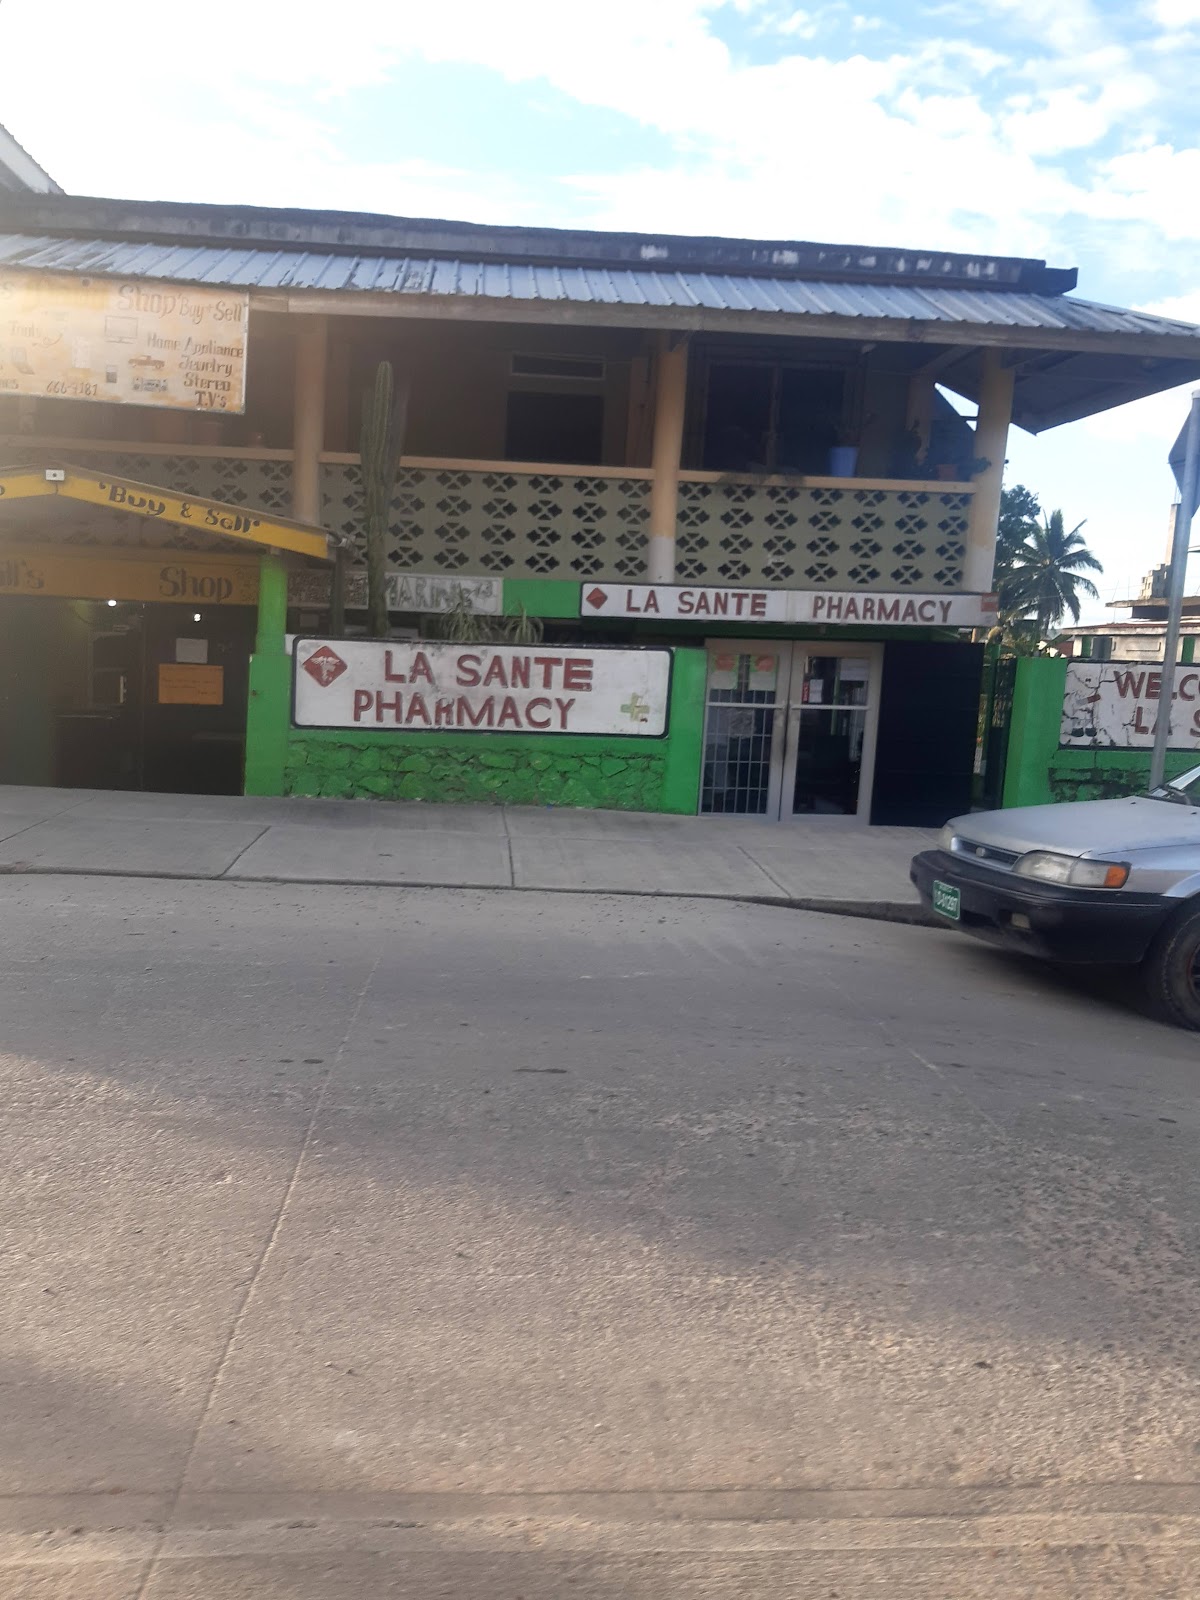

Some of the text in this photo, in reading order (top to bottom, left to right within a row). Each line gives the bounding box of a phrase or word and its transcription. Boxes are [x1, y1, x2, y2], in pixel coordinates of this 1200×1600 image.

[119, 284, 176, 319] Shop
[213, 301, 242, 322] Sell
[183, 372, 231, 392] Stereo
[160, 566, 233, 602] Shop
[626, 588, 953, 623] LA SANTE PHARMACY
[384, 650, 594, 692] LA SANTE
[353, 689, 576, 730] PHARMACY
